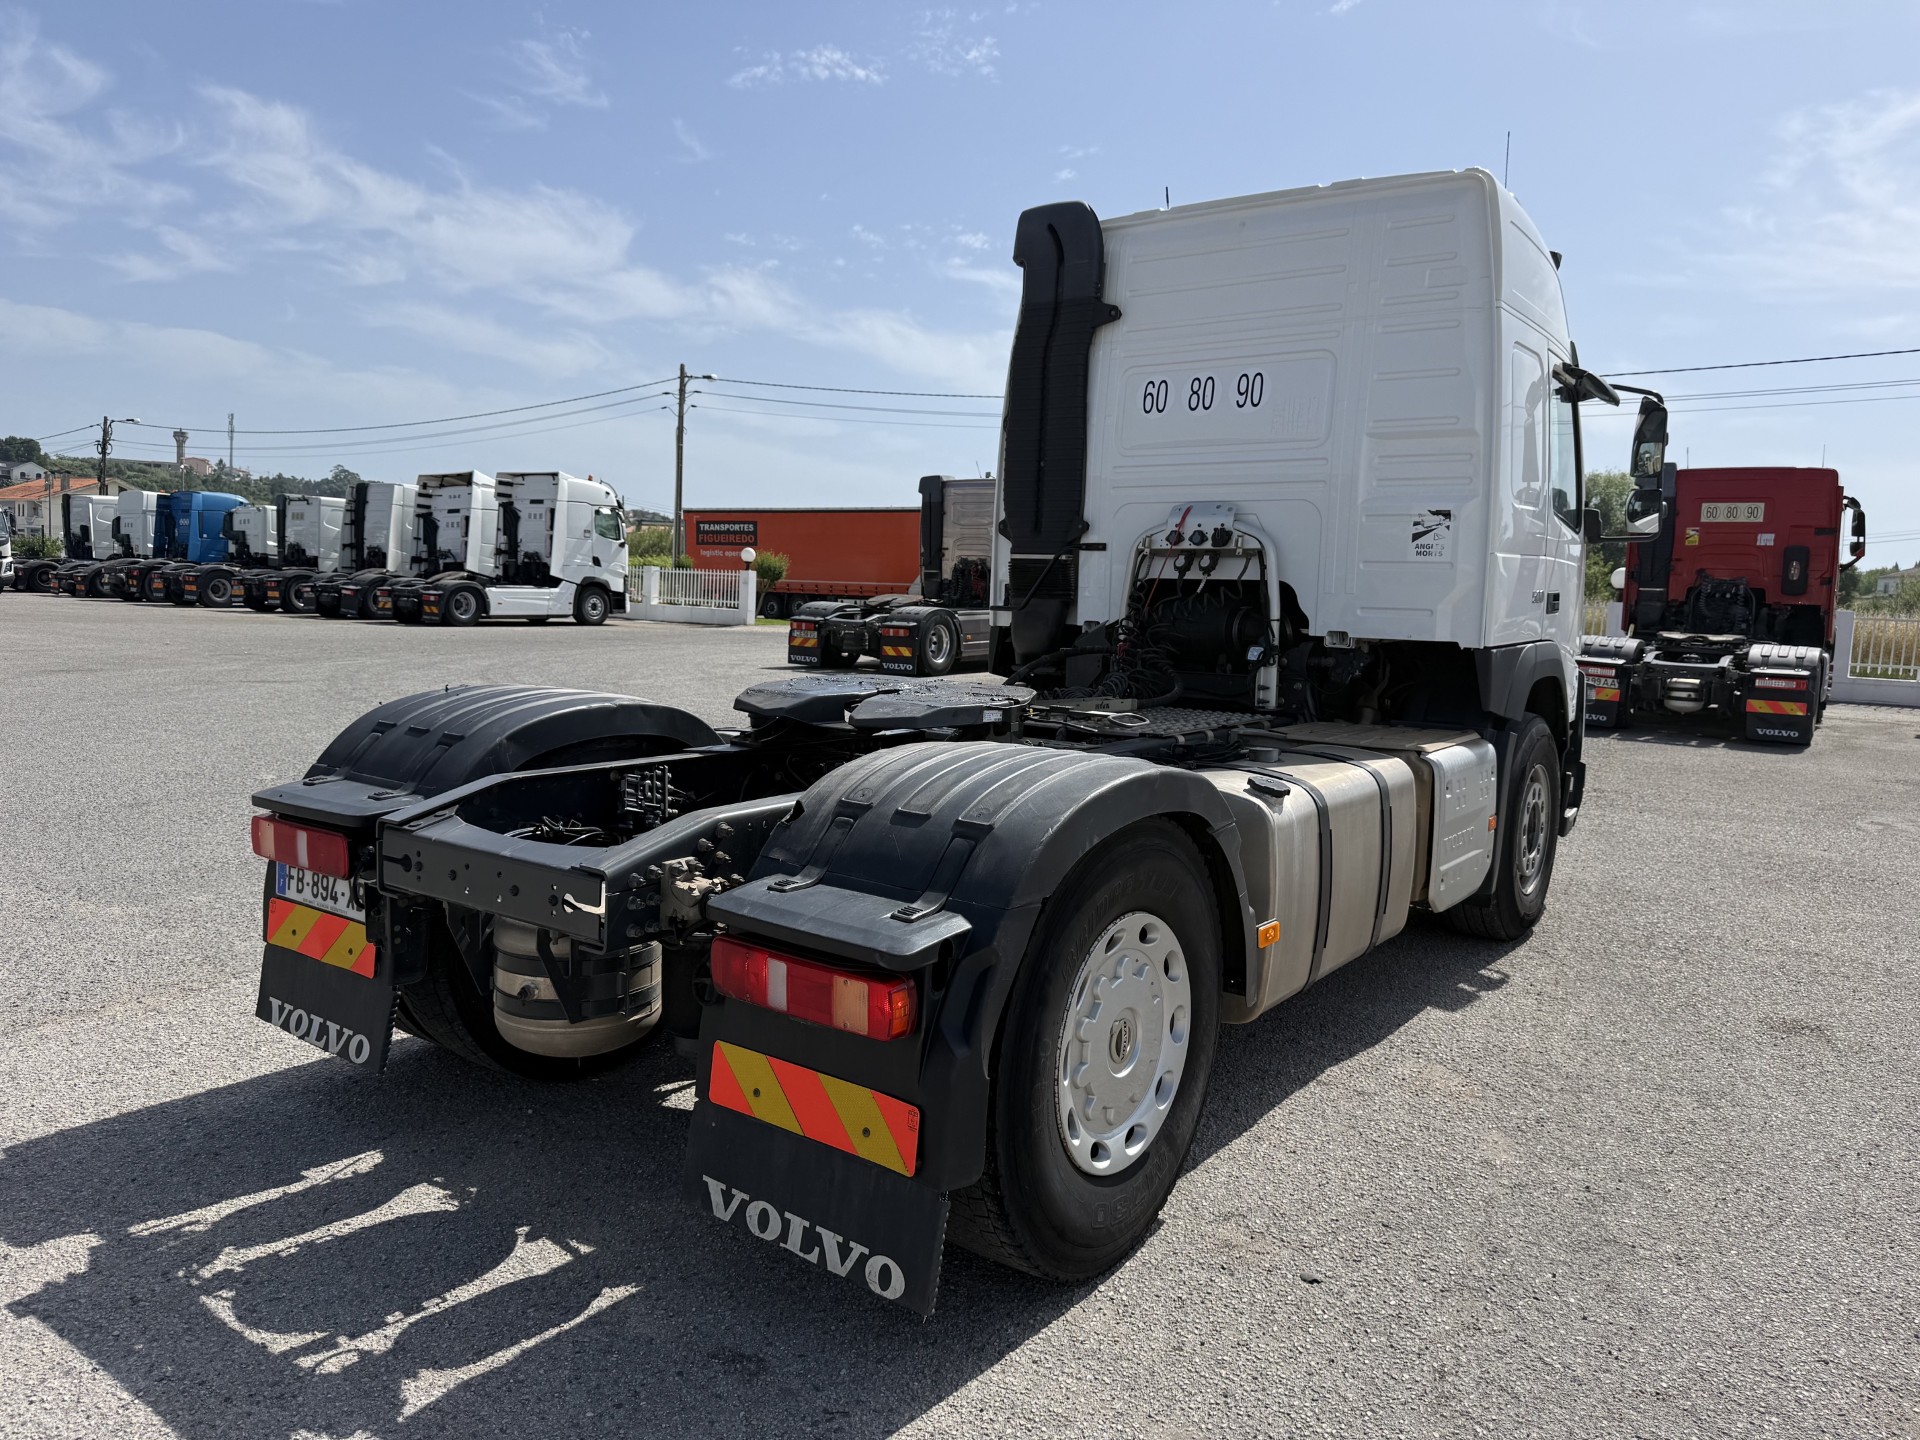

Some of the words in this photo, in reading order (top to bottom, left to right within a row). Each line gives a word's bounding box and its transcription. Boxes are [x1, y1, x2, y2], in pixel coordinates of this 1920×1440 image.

[1142, 379, 1169, 414] 60
[1188, 376, 1215, 412] 80
[1236, 372, 1264, 408] 90
[1706, 506, 1718, 519] 60
[1726, 506, 1738, 519] 80
[1747, 506, 1759, 519] 90
[699, 523, 754, 532] TRANSPORTES
[698, 534, 755, 543] FIGUEIREDO
[700, 548, 724, 558] logistic
[724, 550, 742, 558] oper
[790, 654, 818, 663] VOLVO
[882, 662, 913, 671] VOLVO
[1756, 728, 1799, 737] VOLVO
[269, 996, 370, 1064] VOLVO
[702, 1174, 906, 1300] VOLVO
